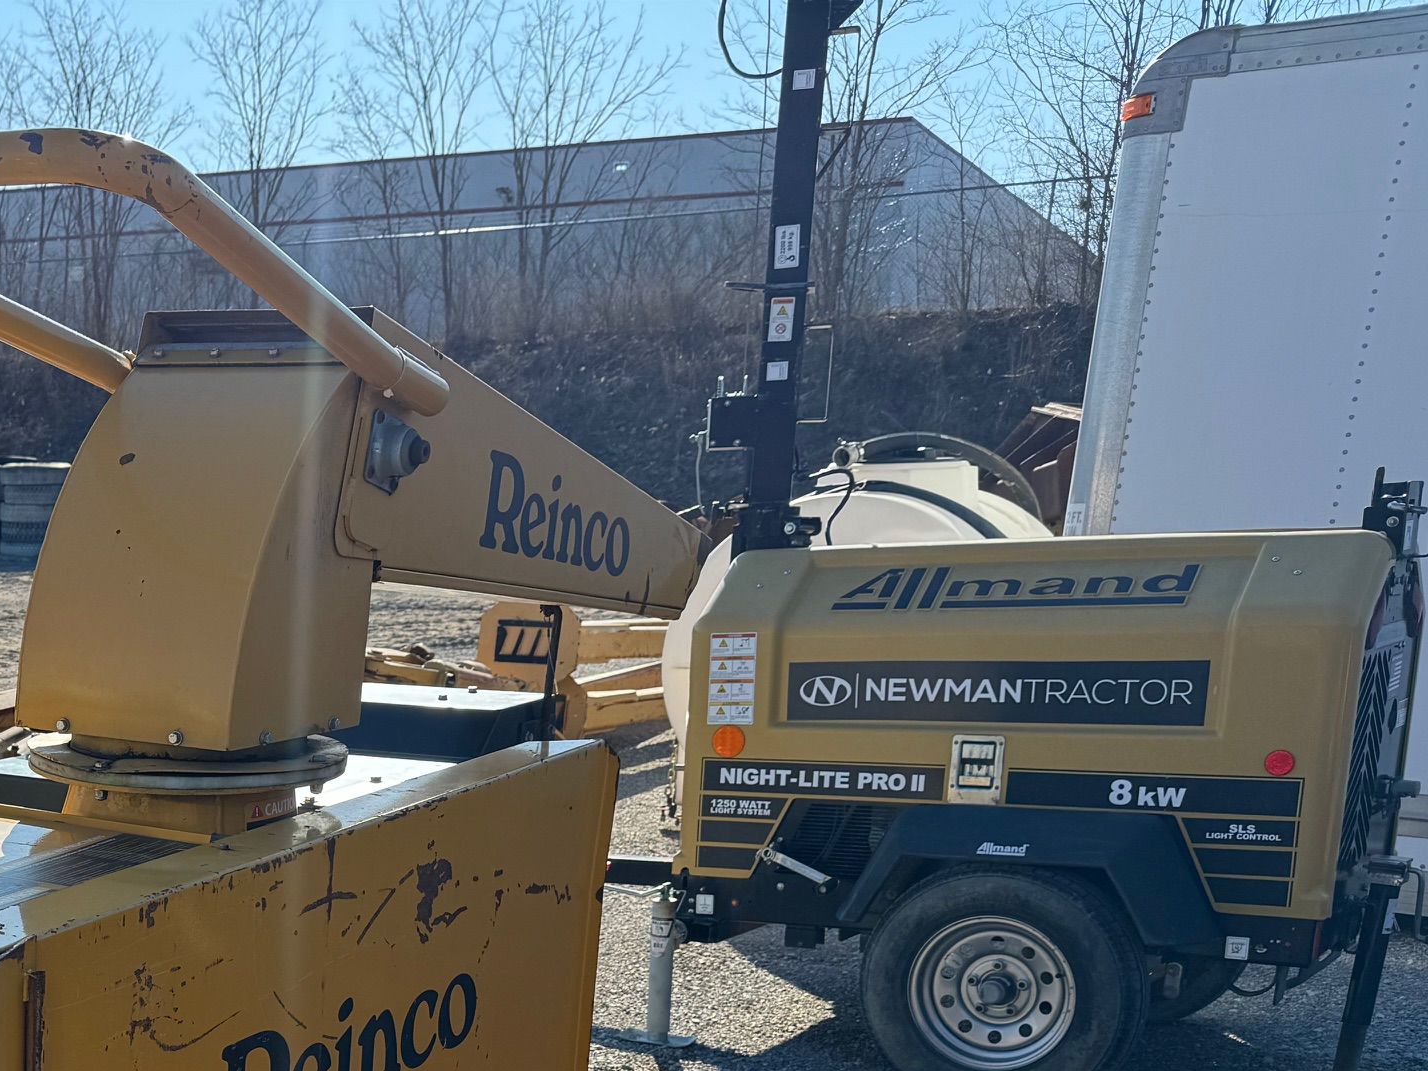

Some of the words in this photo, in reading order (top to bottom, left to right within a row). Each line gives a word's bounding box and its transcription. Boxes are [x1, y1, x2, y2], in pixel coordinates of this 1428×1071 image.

[479, 449, 630, 577] Reinco
[834, 563, 1202, 610] Allmand
[719, 767, 850, 789] NIGHT-LITE
[857, 772, 906, 791] PRO
[911, 774, 926, 792] II
[1108, 779, 1132, 806] 8
[1137, 786, 1187, 808] kW
[265, 797, 296, 816] CAUTIO
[710, 798, 737, 808] 1250
[739, 800, 771, 809] WATT
[737, 808, 771, 816] SYSTEM
[1206, 832, 1234, 840] LIGHT
[1236, 832, 1282, 841] CONTROL
[1229, 824, 1256, 834] SLS
[976, 842, 1027, 856] Allmand
